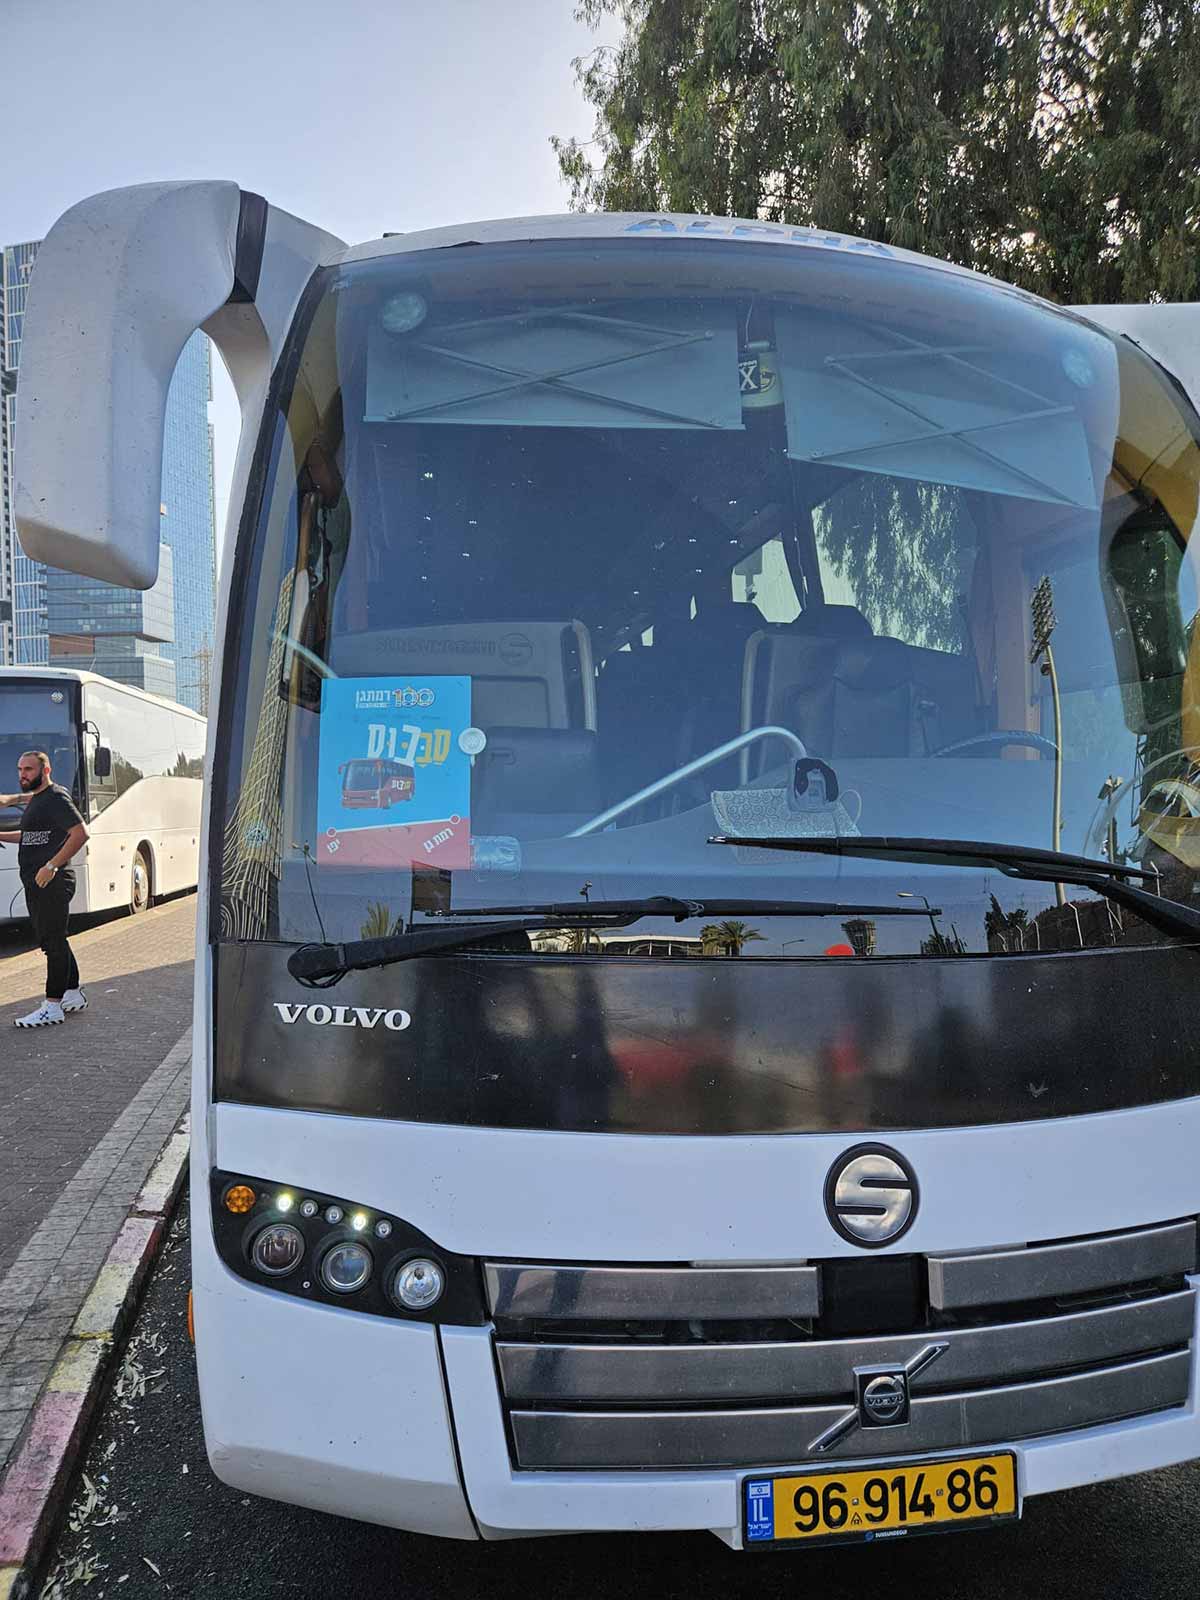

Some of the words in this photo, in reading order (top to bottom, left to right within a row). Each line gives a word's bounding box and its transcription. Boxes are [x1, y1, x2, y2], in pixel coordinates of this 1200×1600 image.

[326, 839, 341, 853] יפו
[423, 839, 434, 853] גן
[431, 827, 454, 846] רמת
[273, 1002, 411, 1031] VOLVO
[753, 1498, 769, 1522] IL
